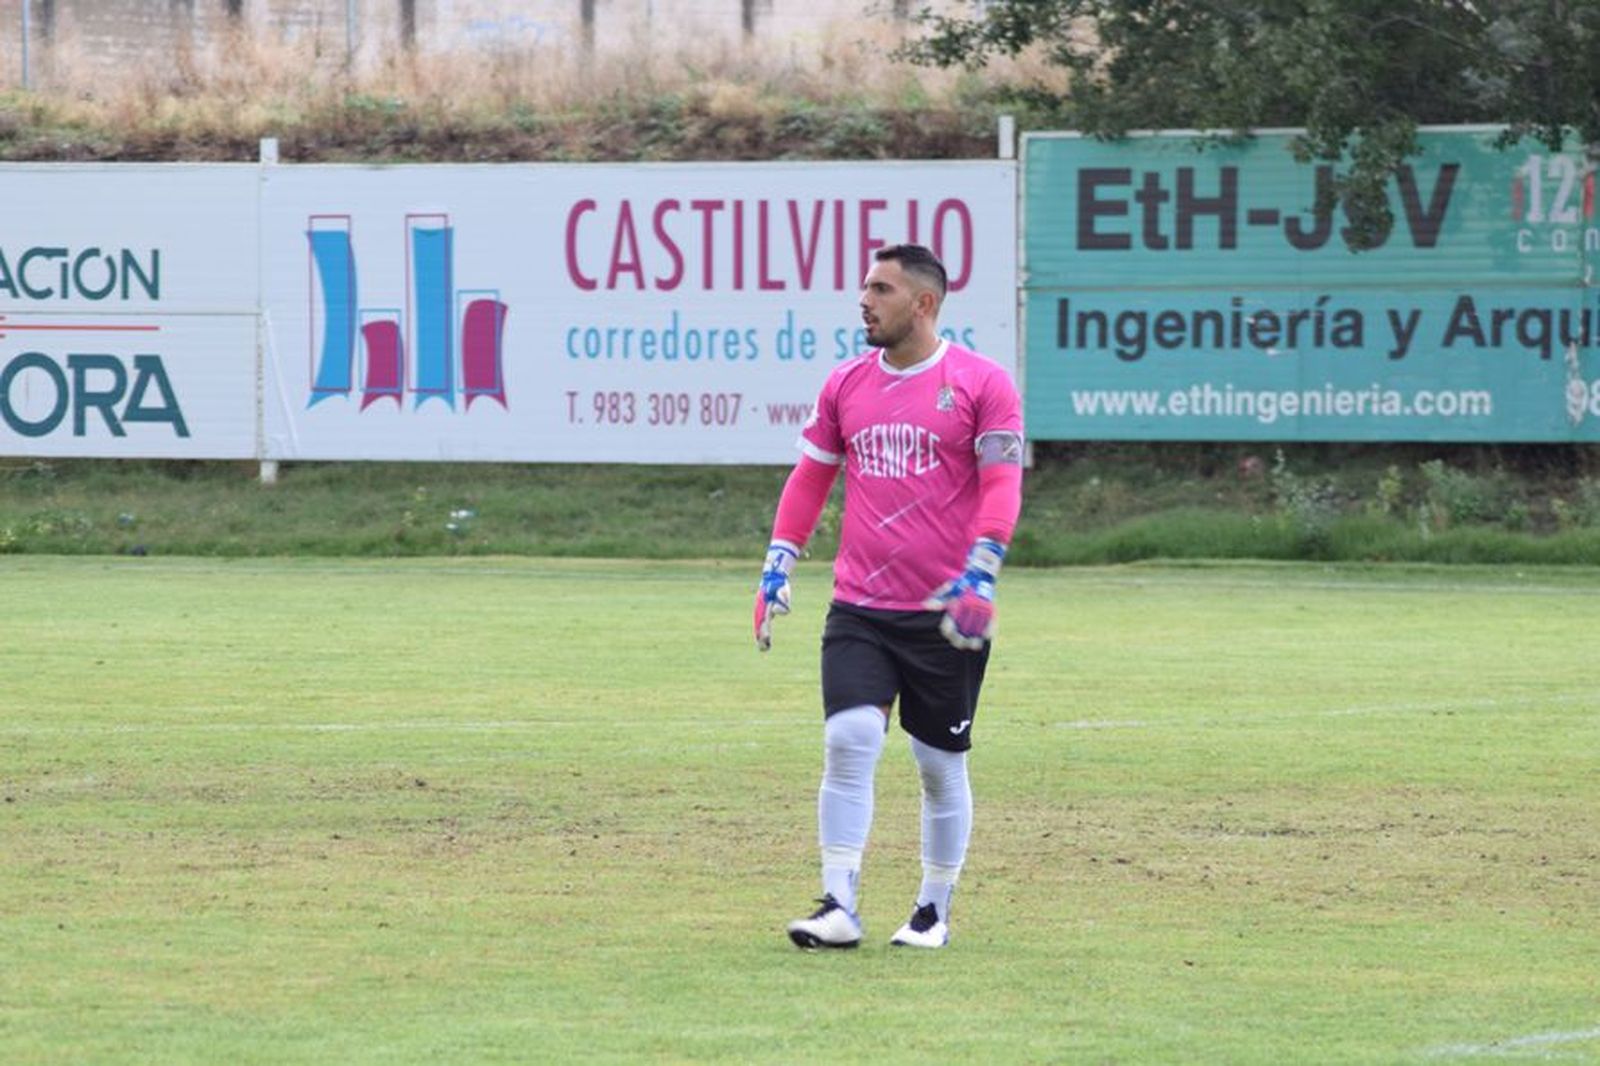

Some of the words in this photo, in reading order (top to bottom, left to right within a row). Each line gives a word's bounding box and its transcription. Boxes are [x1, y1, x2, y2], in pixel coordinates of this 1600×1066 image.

[567, 310, 759, 361] corredores
[776, 310, 817, 361] de
[1057, 297, 1363, 361] Ingeniería
[1386, 309, 1422, 360] y
[1441, 296, 1600, 360] Arqu
[565, 391, 584, 424] T.
[593, 391, 636, 424] 983
[647, 393, 690, 425] 309
[700, 393, 743, 425] 807
[1071, 382, 1493, 423] www.ethingenieria.com
